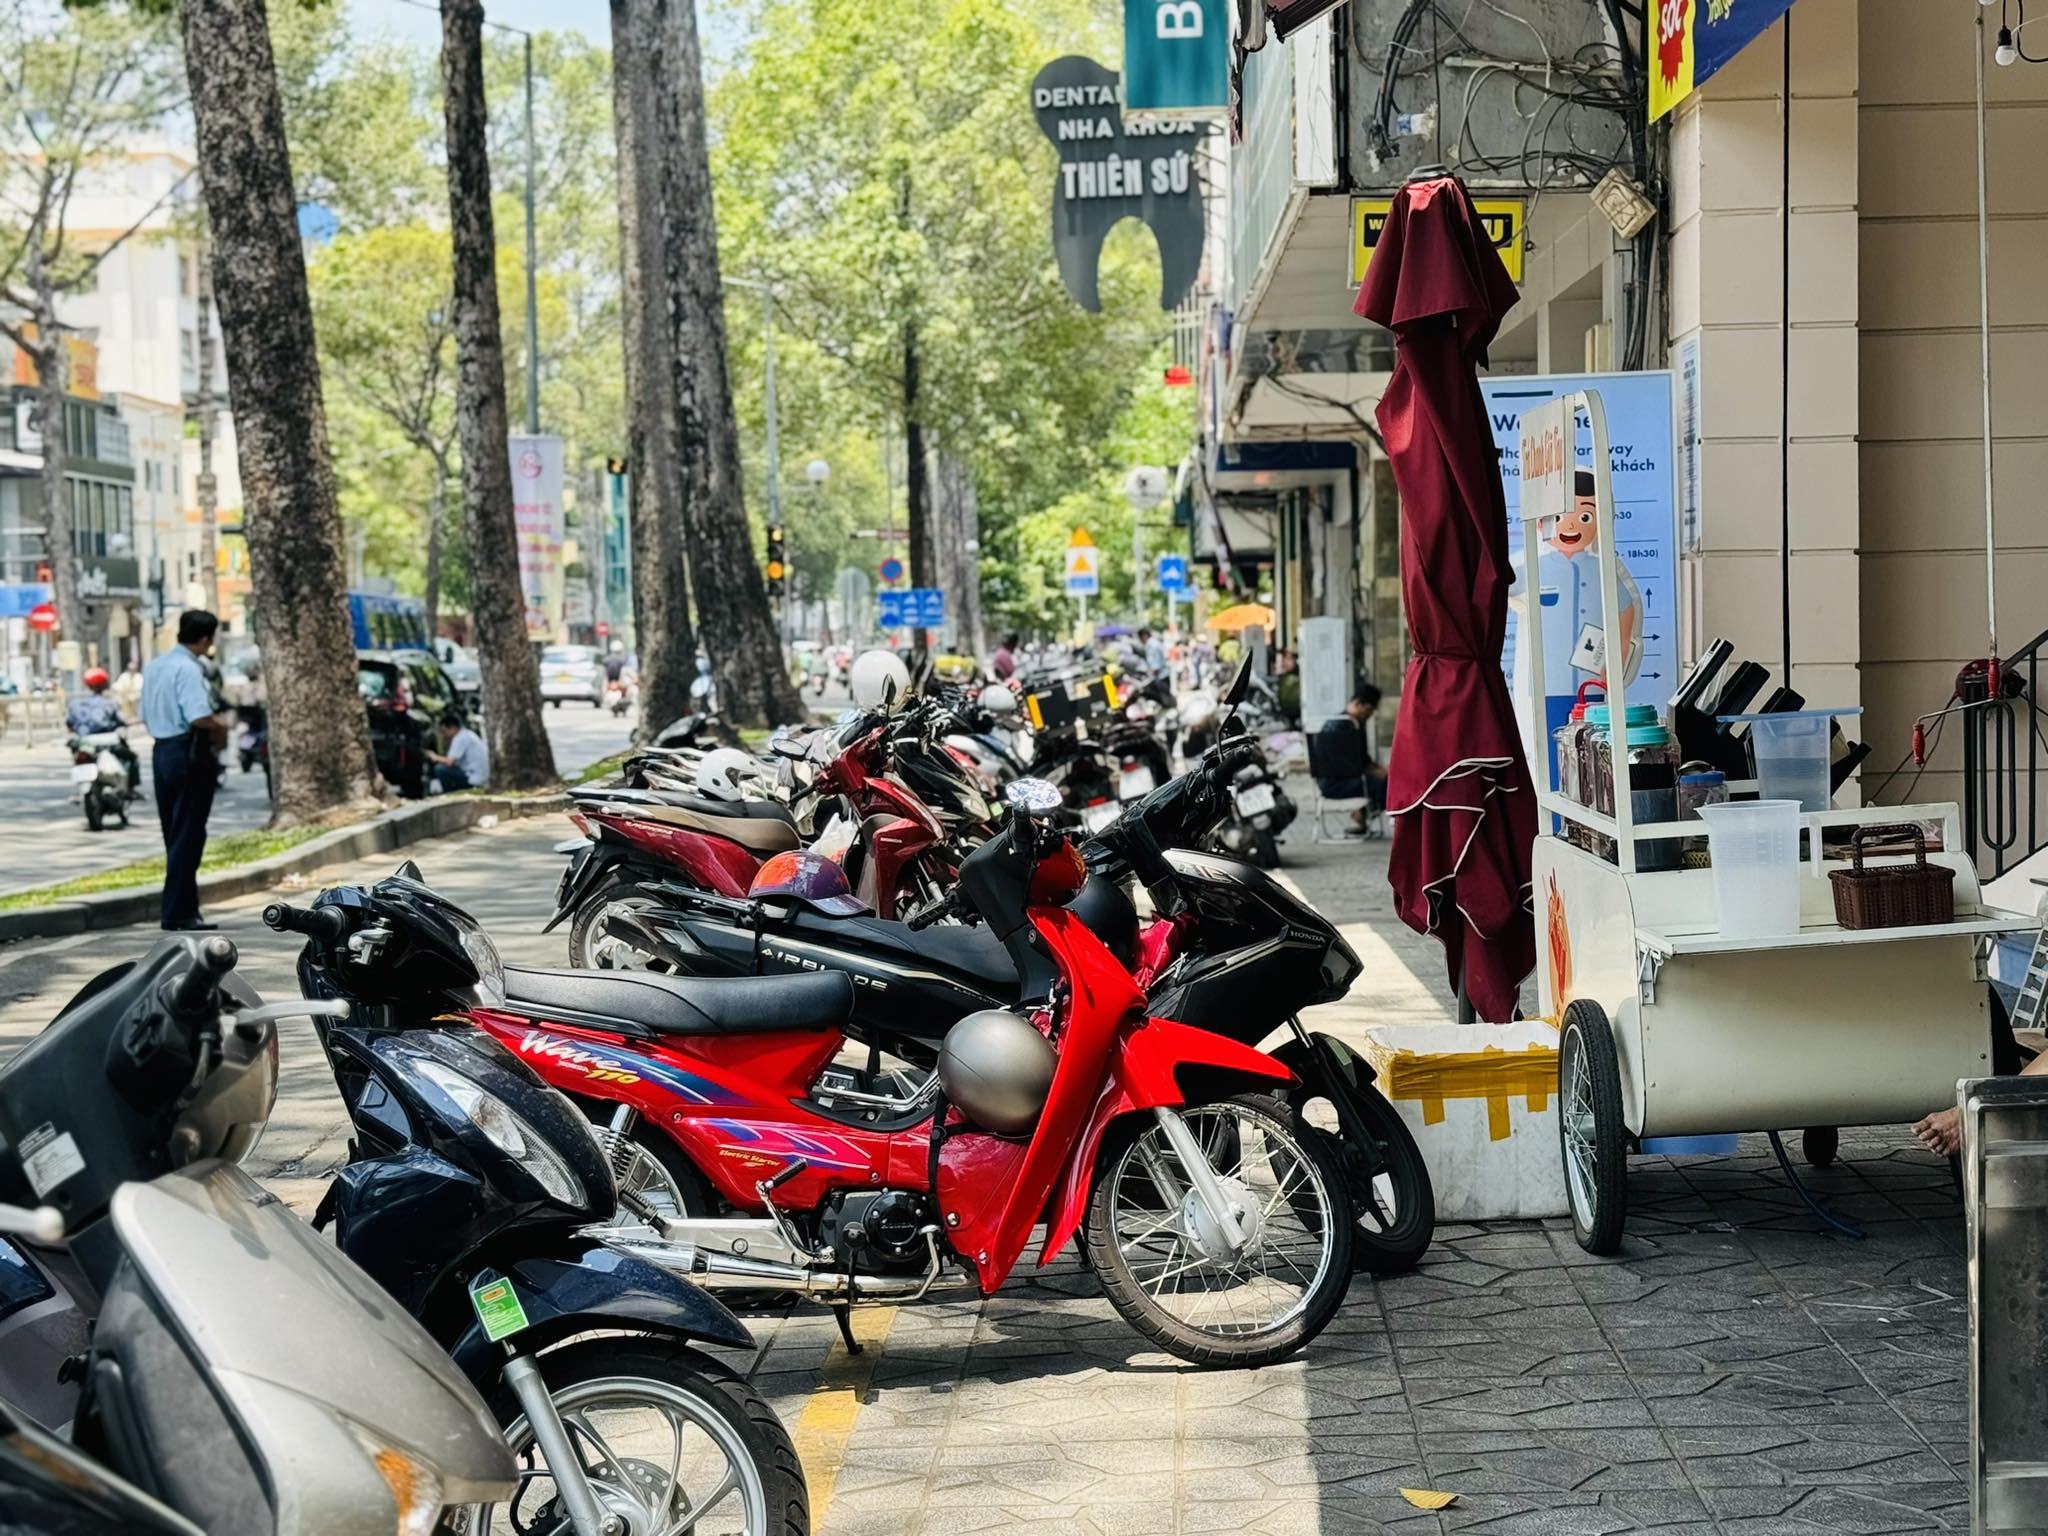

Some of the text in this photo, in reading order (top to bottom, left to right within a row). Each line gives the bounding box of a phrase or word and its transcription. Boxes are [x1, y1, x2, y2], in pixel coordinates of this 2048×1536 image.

[1035, 86, 1121, 108] DENTA
[1058, 118, 1114, 140] NHA
[1061, 153, 1143, 199] THIÊN
[1612, 458, 1655, 472] khách
[1290, 930, 1326, 943] HONDA
[761, 948, 888, 992] AIRBDE
[518, 1029, 638, 1074] Wave
[557, 1060, 641, 1084] HONDA 110
[719, 1149, 781, 1166] Electric Starter
